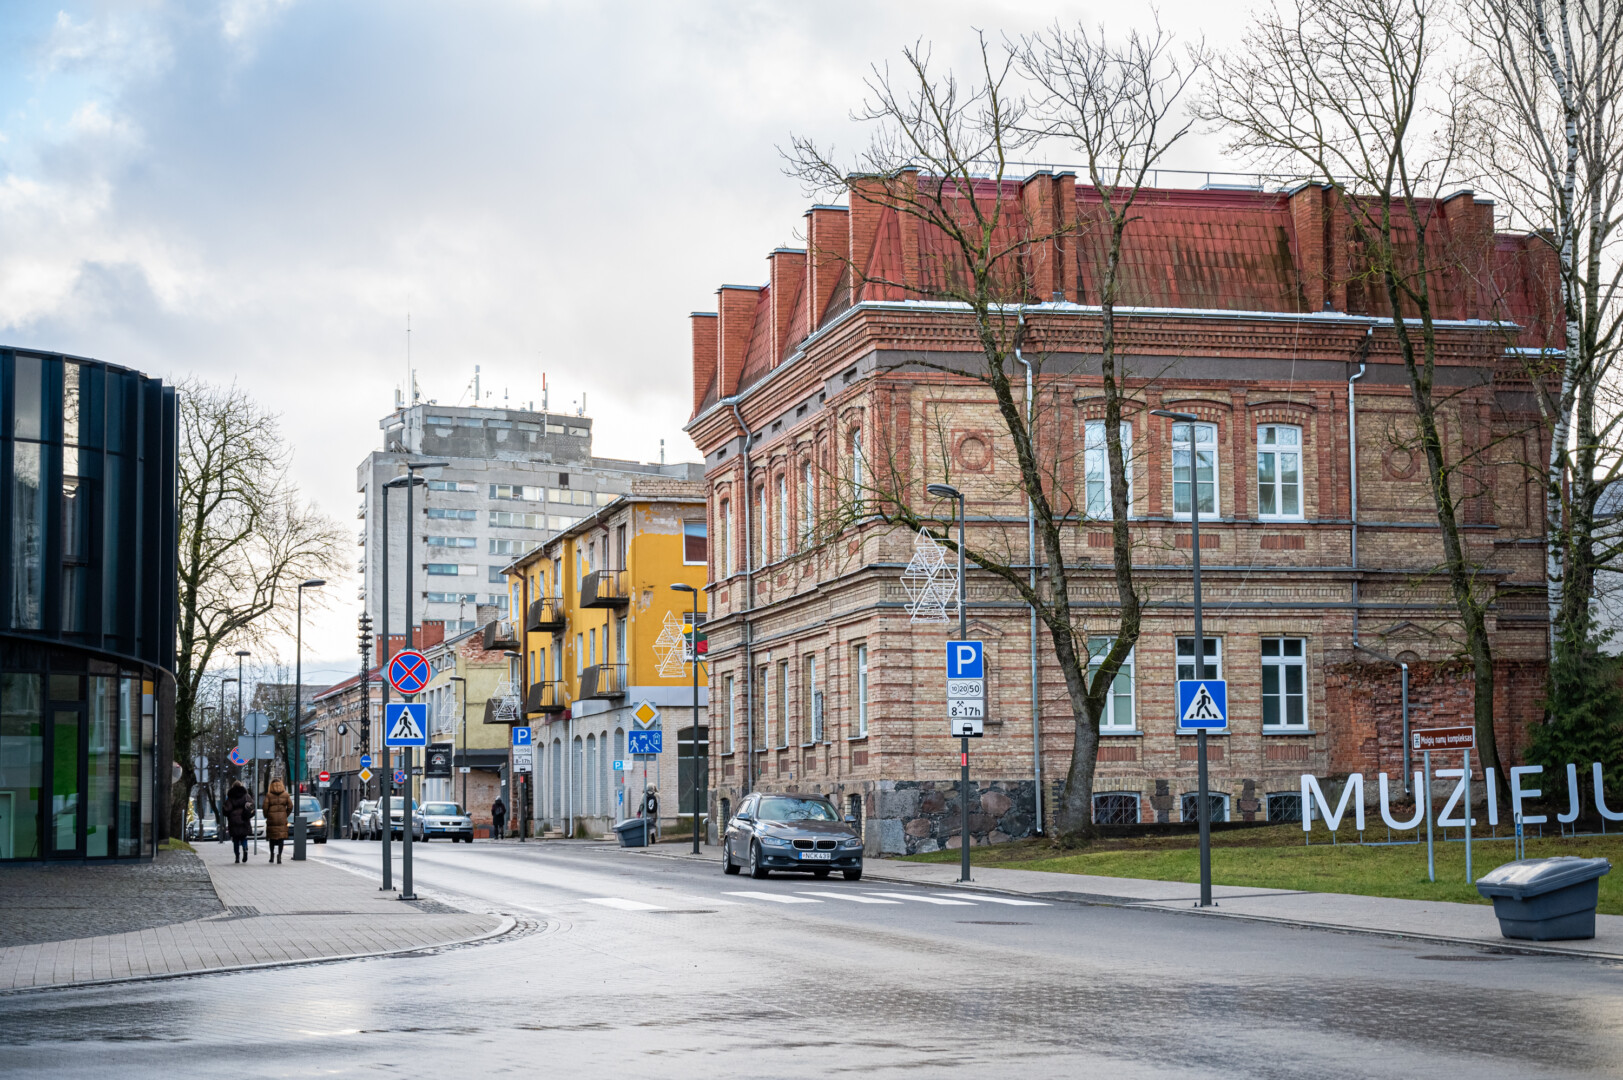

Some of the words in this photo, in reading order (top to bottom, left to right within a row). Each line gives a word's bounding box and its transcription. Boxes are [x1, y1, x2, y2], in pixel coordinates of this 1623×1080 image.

[957, 645, 976, 674] P
[969, 685, 980, 693] 50
[518, 729, 528, 743] P
[1447, 734, 1472, 744] kompleksas
